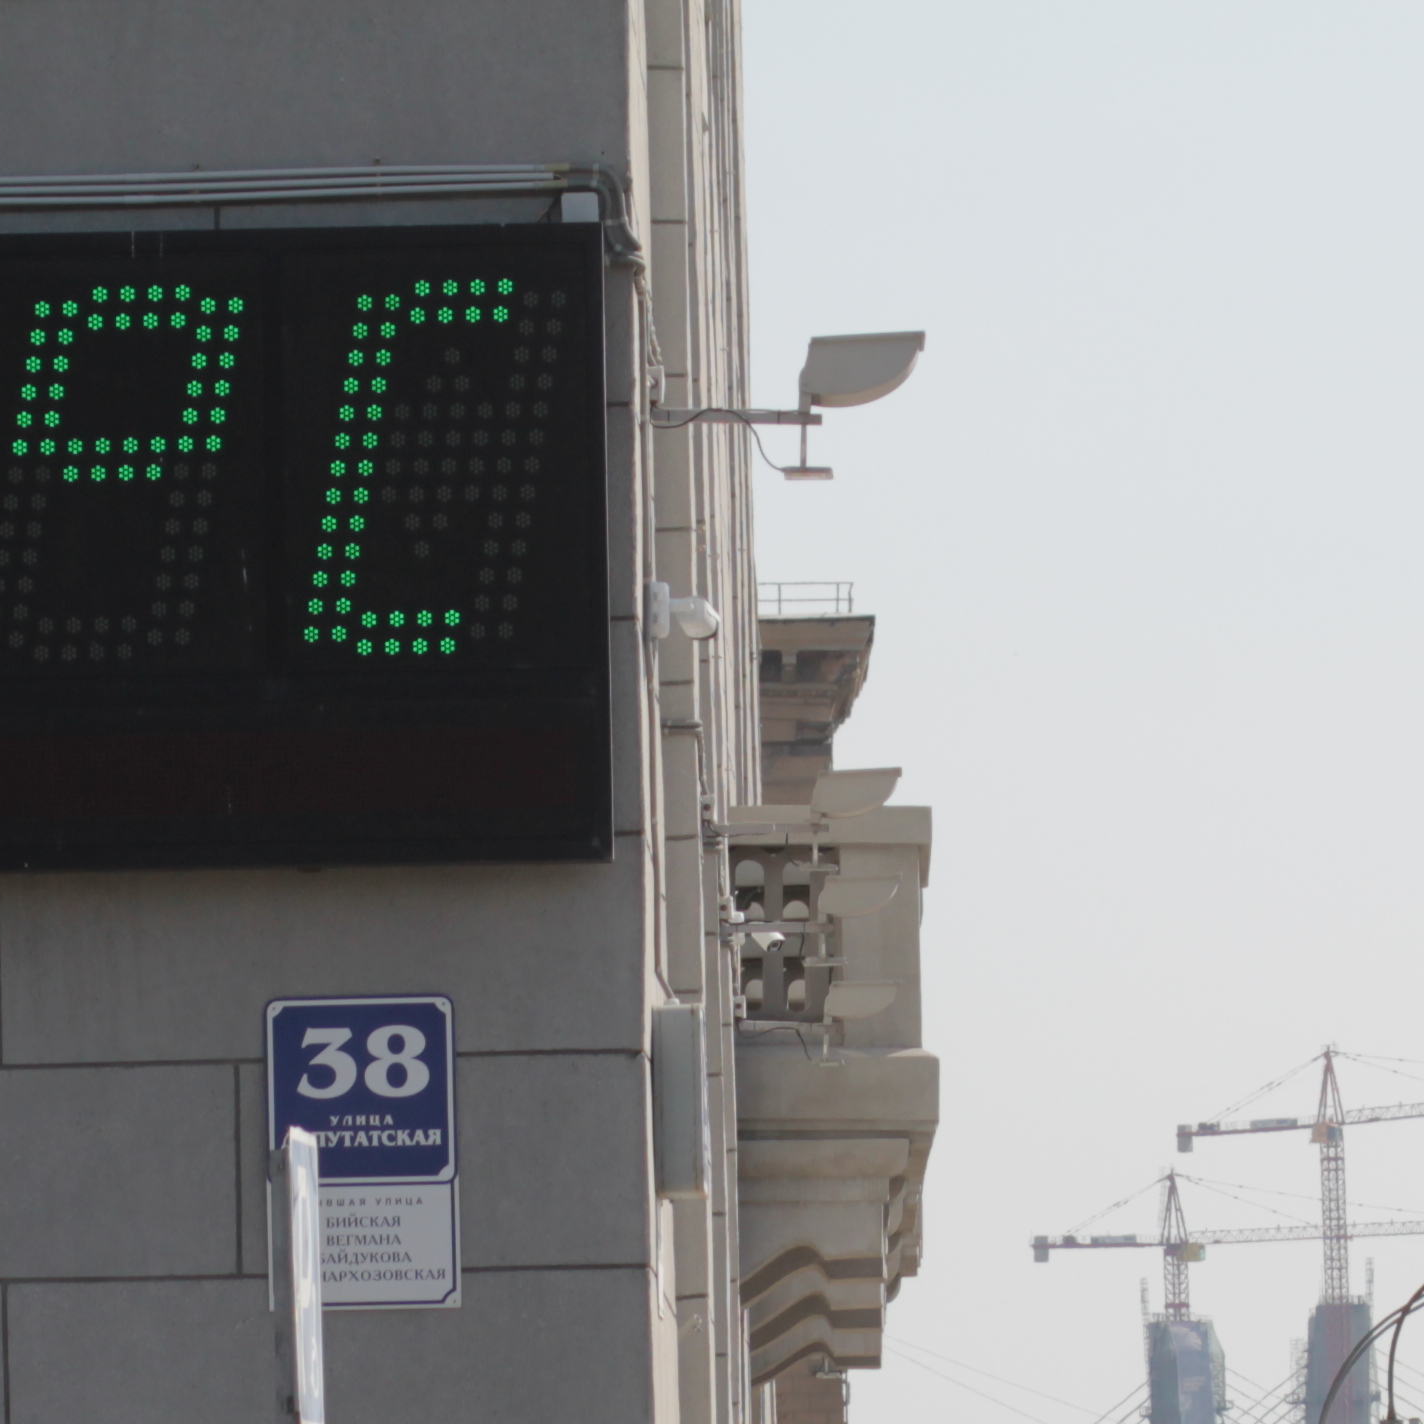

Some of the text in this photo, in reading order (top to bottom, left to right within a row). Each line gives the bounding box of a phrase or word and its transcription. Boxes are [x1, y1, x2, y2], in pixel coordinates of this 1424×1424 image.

[296, 1024, 430, 1100] 38
[329, 1114, 394, 1127] УЛИЦА
[281, 1128, 442, 1149] ПУТАТСКАЯ
[319, 1196, 424, 1207] ВШАЯ УЛИЦА
[326, 1212, 401, 1229] БИЙСКАЯ
[326, 1233, 402, 1247] ВЕГМАНА
